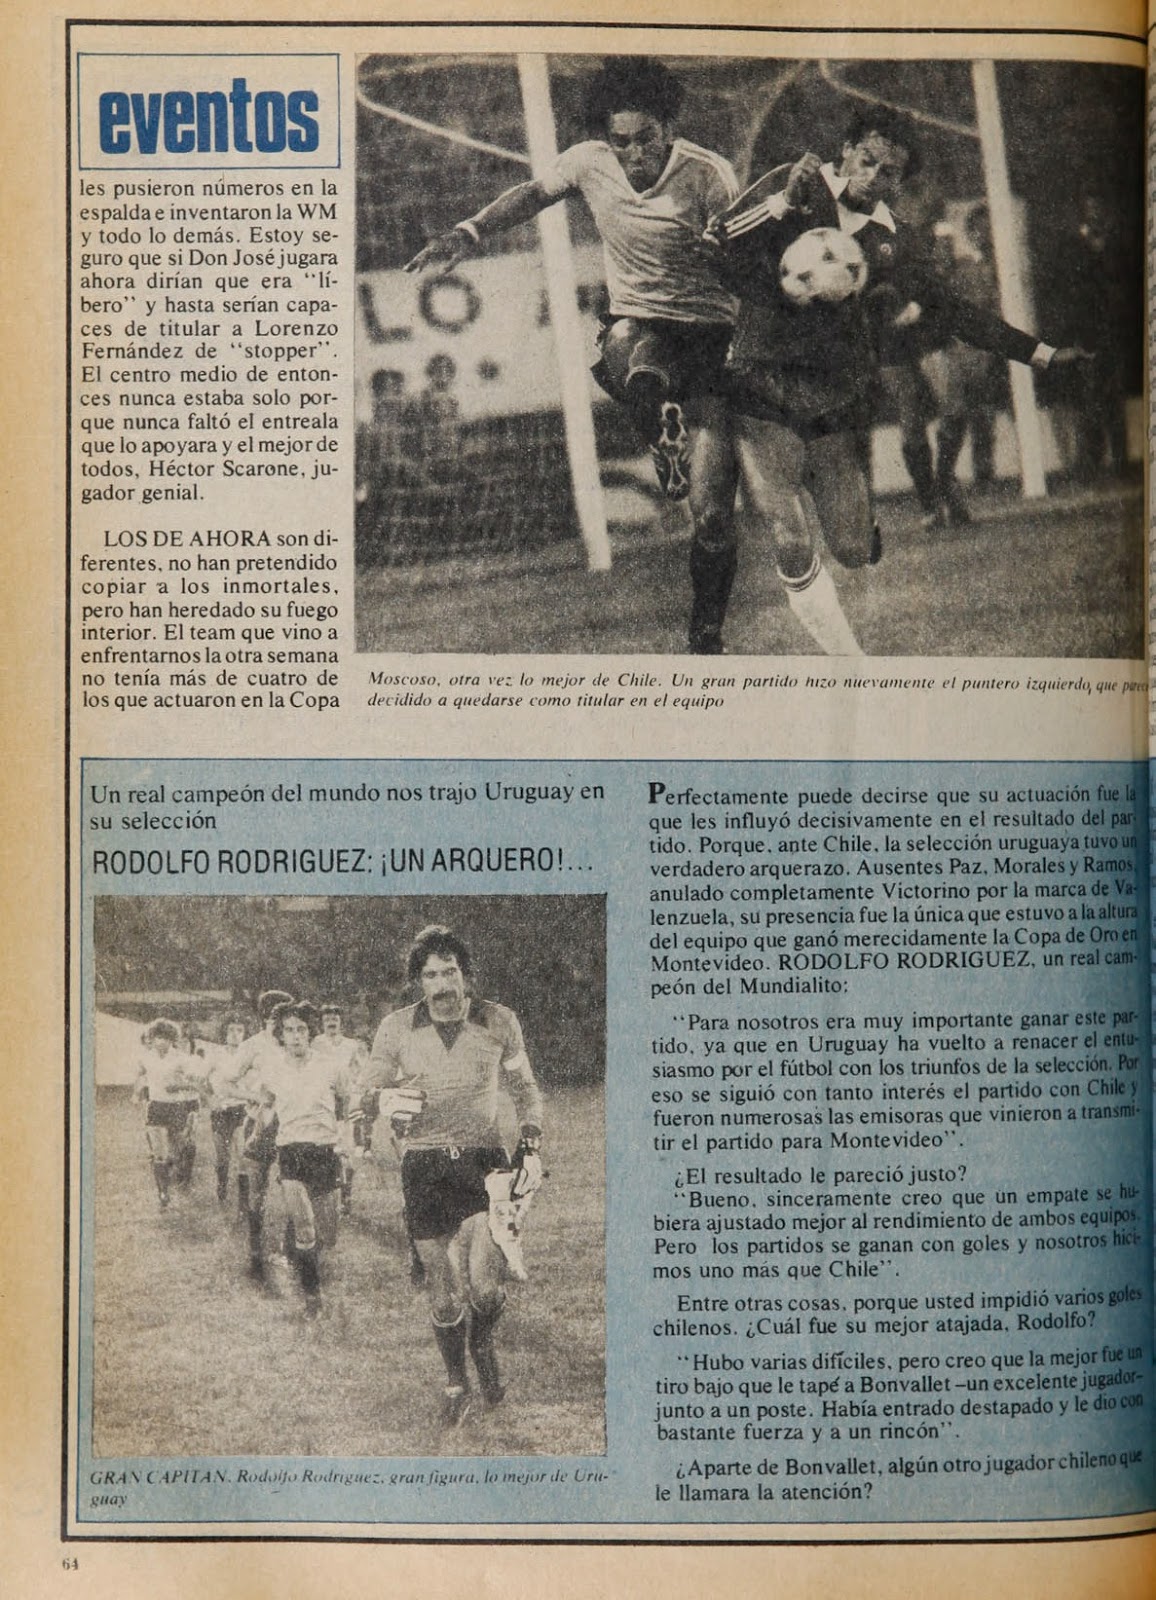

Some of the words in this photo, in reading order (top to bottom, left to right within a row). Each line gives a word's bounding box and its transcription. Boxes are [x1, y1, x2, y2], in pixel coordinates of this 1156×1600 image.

[99, 77, 319, 154] eventos
[80, 178, 105, 196] les
[113, 178, 194, 199] pusieron
[202, 178, 284, 196] números
[291, 183, 313, 195] en
[321, 178, 338, 195] la
[79, 203, 151, 224] espalda
[154, 208, 164, 220] e
[170, 202, 272, 220] inventaron
[276, 203, 292, 219] la
[297, 202, 337, 219] WM
[80, 253, 123, 269] guro
[128, 253, 161, 270] que
[168, 248, 183, 265] si
[189, 248, 228, 265] Don
[232, 248, 275, 265] José
[277, 248, 338, 269] jugara
[80, 324, 112, 336] ces
[124, 319, 147, 336] de
[159, 318, 220, 336] titular
[232, 324, 242, 336] a
[255, 319, 338, 336] Lorenzo
[104, 530, 147, 547] LOS
[153, 530, 183, 546] DE
[189, 529, 271, 546] AHORA
[277, 534, 308, 546] son
[313, 529, 338, 546] di-
[80, 553, 162, 571] ferentes,
[168, 558, 191, 571] no
[197, 553, 230, 570] han
[236, 553, 337, 574] pretendido
[80, 645, 201, 663] enfrentarnos
[205, 646, 222, 663] la
[225, 649, 263, 663] otra
[267, 650, 339, 663] semana
[368, 671, 440, 686] Moscoso,
[449, 675, 480, 685] otra
[488, 676, 512, 686] vez
[519, 672, 534, 685] lo
[541, 673, 585, 689] mejor
[592, 672, 610, 686] de
[617, 672, 661, 686] Chile.
[672, 673, 693, 686] Un
[700, 677, 735, 689] gran
[742, 674, 798, 690] partido
[805, 676, 837, 688] hizo
[843, 678, 935, 688] nuevamente
[942, 676, 956, 688] el
[961, 678, 1020, 691] puntero
[1026, 676, 1091, 695] izquierdo,
[1096, 681, 1117, 693] que
[83, 690, 109, 707] los
[114, 695, 148, 711] que
[153, 693, 236, 707] actuaron
[240, 695, 263, 707] en
[269, 691, 285, 707] la
[289, 690, 340, 711] Copa
[367, 692, 432, 706] decidido
[437, 696, 447, 706] a
[453, 692, 523, 709] quedarse
[529, 696, 571, 706] como
[577, 692, 625, 706] titular
[630, 697, 647, 706] en
[653, 692, 668, 707] el
[672, 694, 724, 710] equipo
[90, 785, 121, 803] Un
[128, 784, 165, 803] real
[171, 784, 264, 806] campeón
[271, 783, 302, 802] del
[309, 782, 380, 801] mundo
[386, 787, 423, 801] nos
[428, 781, 477, 804] trajo
[485, 781, 574, 804] Uruguay
[580, 785, 604, 799] en
[648, 782, 788, 805] Perfectamente
[798, 786, 852, 808] puede
[861, 786, 928, 803] decirse
[936, 790, 970, 807] que
[979, 790, 998, 803] su
[1006, 784, 1090, 802] actuación
[1097, 784, 1119, 801] fue
[1125, 784, 1136, 801] la
[89, 816, 112, 830] su
[121, 809, 217, 829] selección
[93, 849, 210, 875] RODOLFO
[218, 848, 372, 874] RODRIGUEZ:
[650, 859, 745, 877] verdadero
[749, 863, 850, 880] arquerazo.
[856, 859, 943, 875] Ausentes
[949, 857, 988, 875] Paz,
[993, 856, 1065, 874] Morales
[1069, 860, 1078, 876] y
[651, 953, 770, 972] Montevideo.
[778, 952, 889, 970] RODOLFO
[897, 949, 1035, 968] RODRIGUEZ,
[1043, 953, 1064, 966] un
[1070, 948, 1100, 966] real
[651, 977, 695, 999] peón
[703, 977, 731, 995] del
[740, 975, 848, 994] Mundialito:
[653, 1109, 714, 1126] fueron
[720, 1112, 823, 1126] numerosas
[828, 1107, 854, 1124] las
[859, 1106, 943, 1124] emisoras
[949, 1110, 982, 1127] que
[989, 1104, 1062, 1122] vinieron
[1067, 1107, 1077, 1120] a
[1081, 1099, 1140, 1119] transmi-
[674, 1167, 706, 1188] ¿El
[714, 1166, 802, 1184] resultado
[810, 1166, 826, 1184] le
[833, 1164, 904, 1186] pareció
[907, 1164, 966, 1186] justo?
[653, 1213, 701, 1231] biera
[706, 1213, 786, 1234] ajustado
[792, 1212, 846, 1233] mejor
[851, 1212, 867, 1229] al
[873, 1210, 986, 1229] rendimiento
[991, 1210, 1013, 1227] de
[1018, 1208, 1075, 1227] ambos
[652, 1318, 737, 1336] chilenos.
[746, 1316, 801, 1338] ¿Cuál
[808, 1315, 837, 1334] fue
[845, 1320, 866, 1333] su
[874, 1315, 929, 1336] mejor
[935, 1313, 1009, 1335] atajada,
[1017, 1310, 1095, 1330] Rodolfo?
[90, 1470, 141, 1484] GRAN
[390, 1474, 424, 1484] gran
[484, 1469, 498, 1483] lo
[502, 1473, 547, 1485] mejor
[550, 1469, 568, 1482] de
[574, 1469, 608, 1482] Uru-
[89, 1495, 127, 1508] guay
[655, 1484, 670, 1501] le
[679, 1483, 750, 1501] llamara
[757, 1482, 774, 1500] la
[781, 1481, 873, 1500] atención?
[62, 1557, 79, 1571] 64
